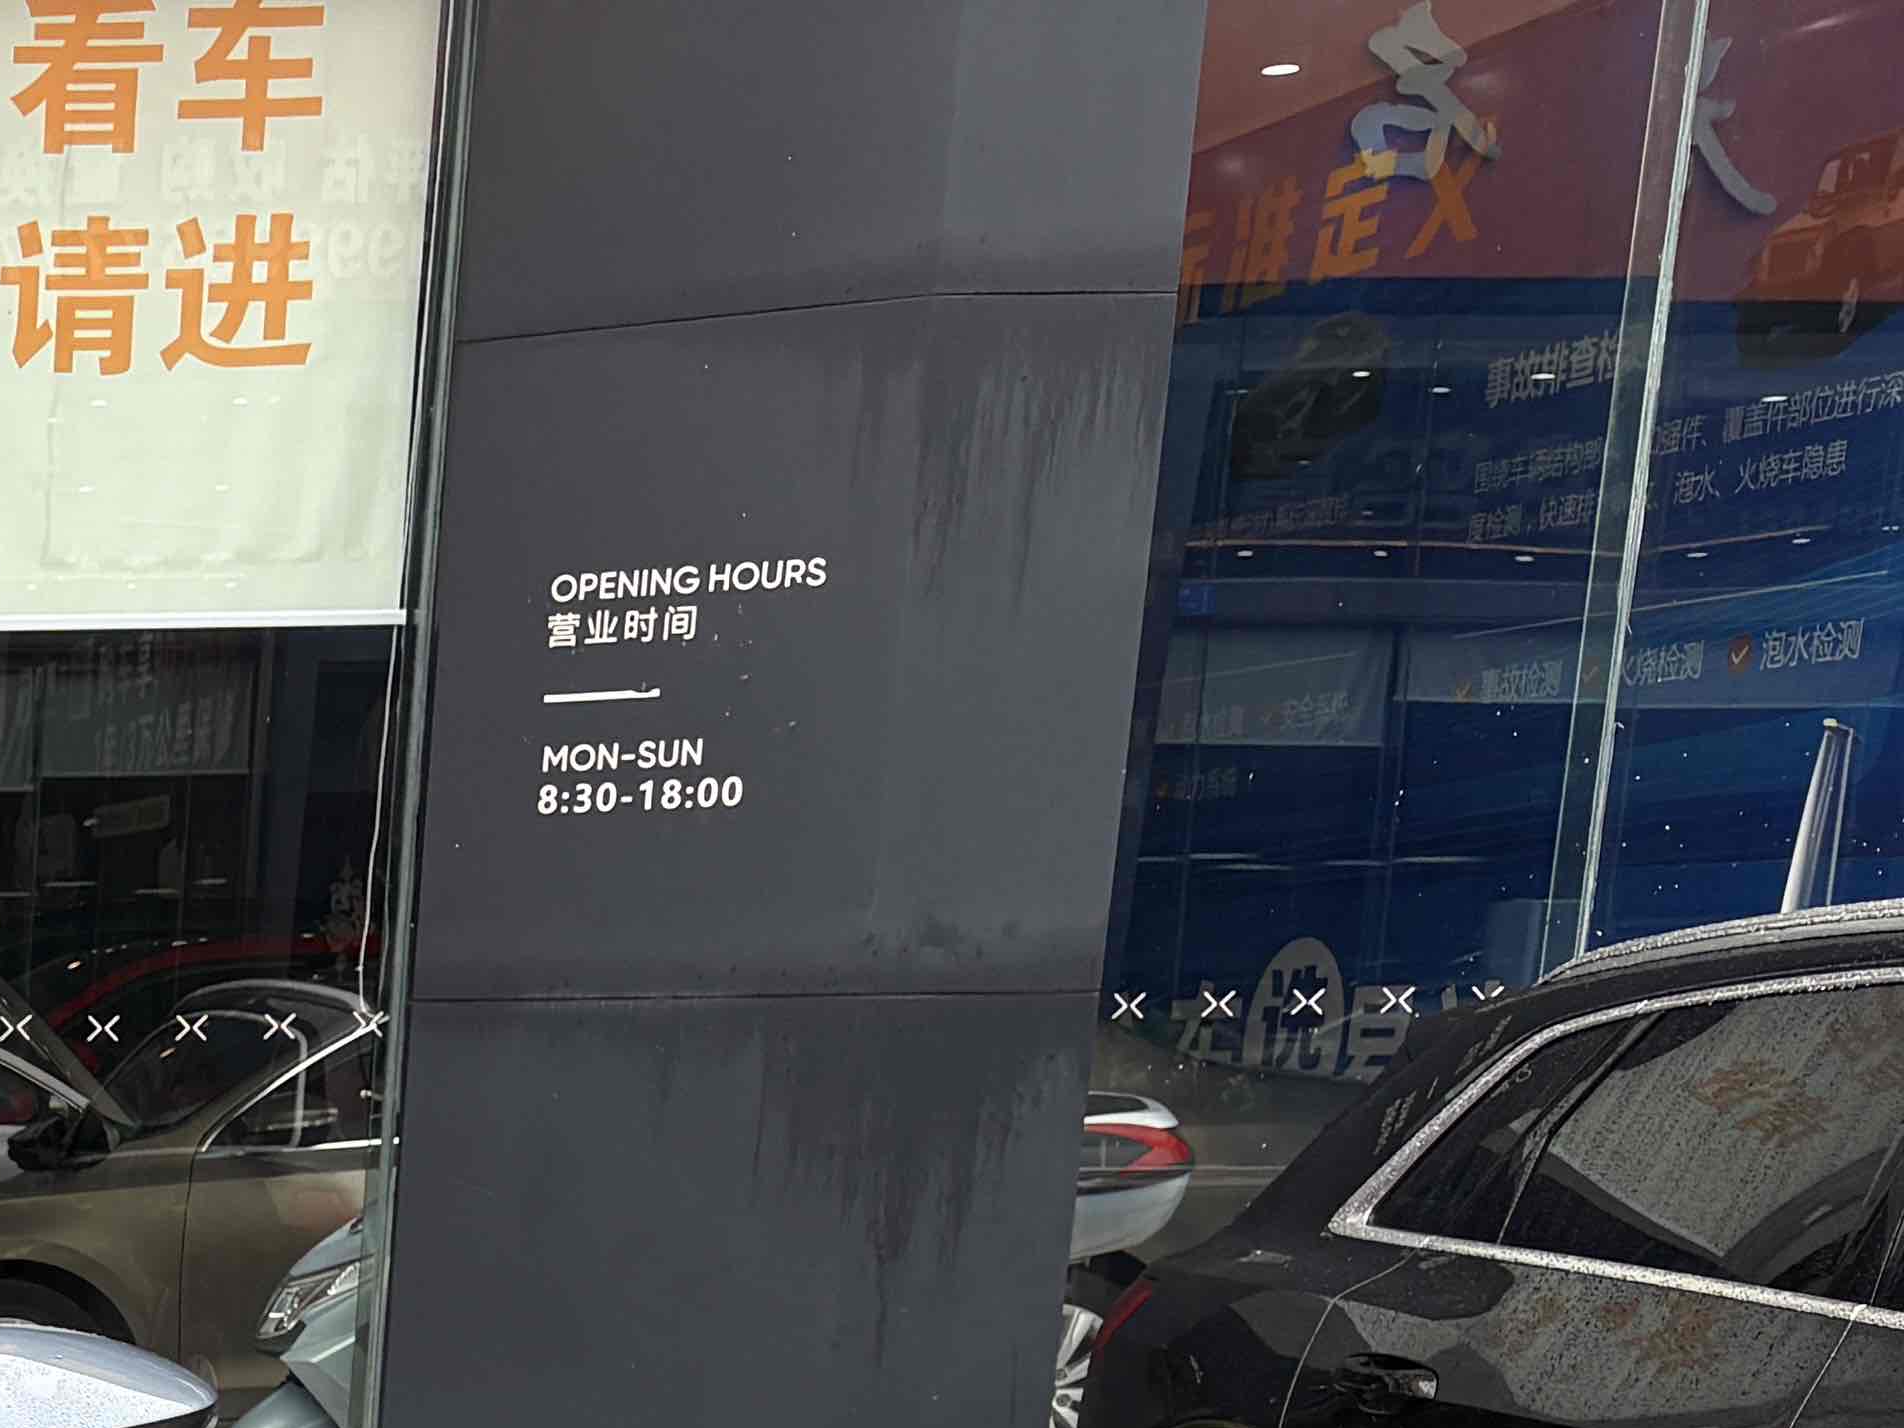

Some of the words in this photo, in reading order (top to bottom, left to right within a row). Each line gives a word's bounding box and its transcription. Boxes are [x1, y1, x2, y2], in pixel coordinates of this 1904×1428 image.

[10, 0, 327, 156] 看车
[0, 212, 316, 376] 请进
[550, 565, 701, 603] OPENING
[708, 557, 827, 592] HOURS
[547, 605, 699, 648] 营业时间
[1759, 618, 1865, 672] 泡水检测
[542, 738, 704, 772] MON-SUN
[537, 775, 744, 816] 8:30-18:00
